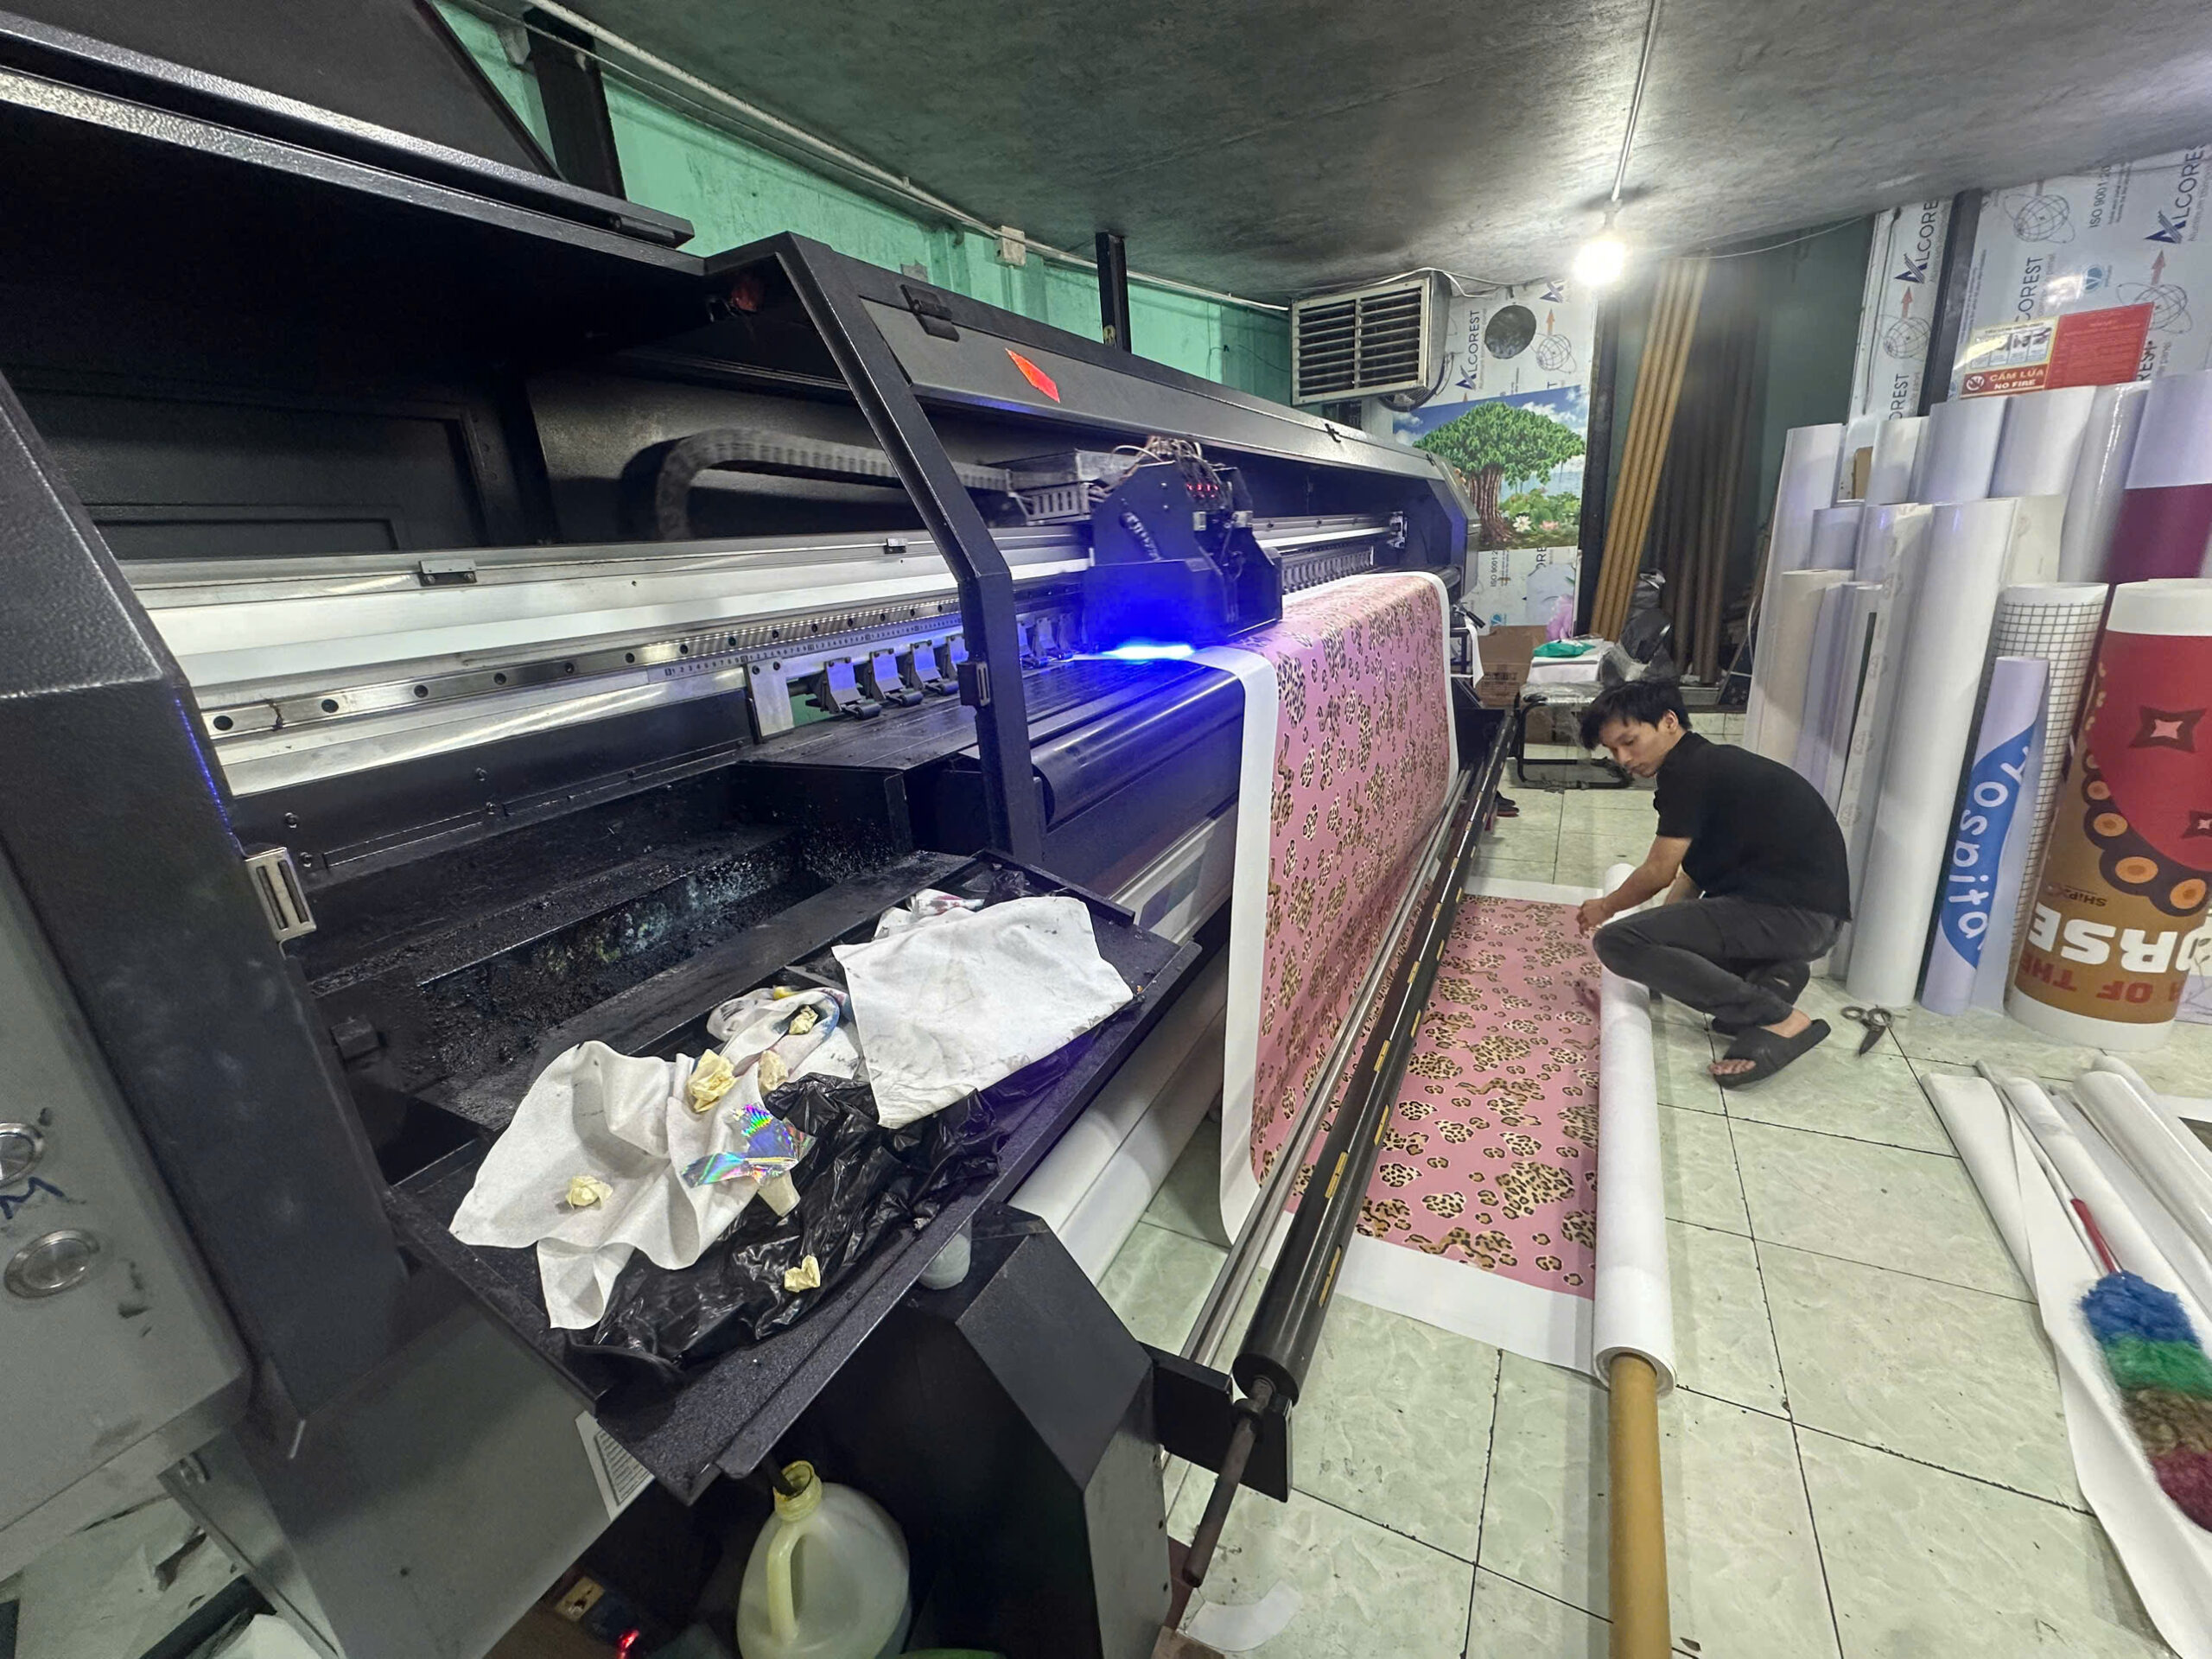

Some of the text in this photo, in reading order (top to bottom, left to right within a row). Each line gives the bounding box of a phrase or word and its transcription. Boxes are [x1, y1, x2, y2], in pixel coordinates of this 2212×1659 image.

[2144, 144, 2204, 244] ALCORE
[1455, 310, 1480, 390] ALCOREST
[2012, 379, 2037, 388] FIRE
[2096, 980, 2153, 1003] OF
